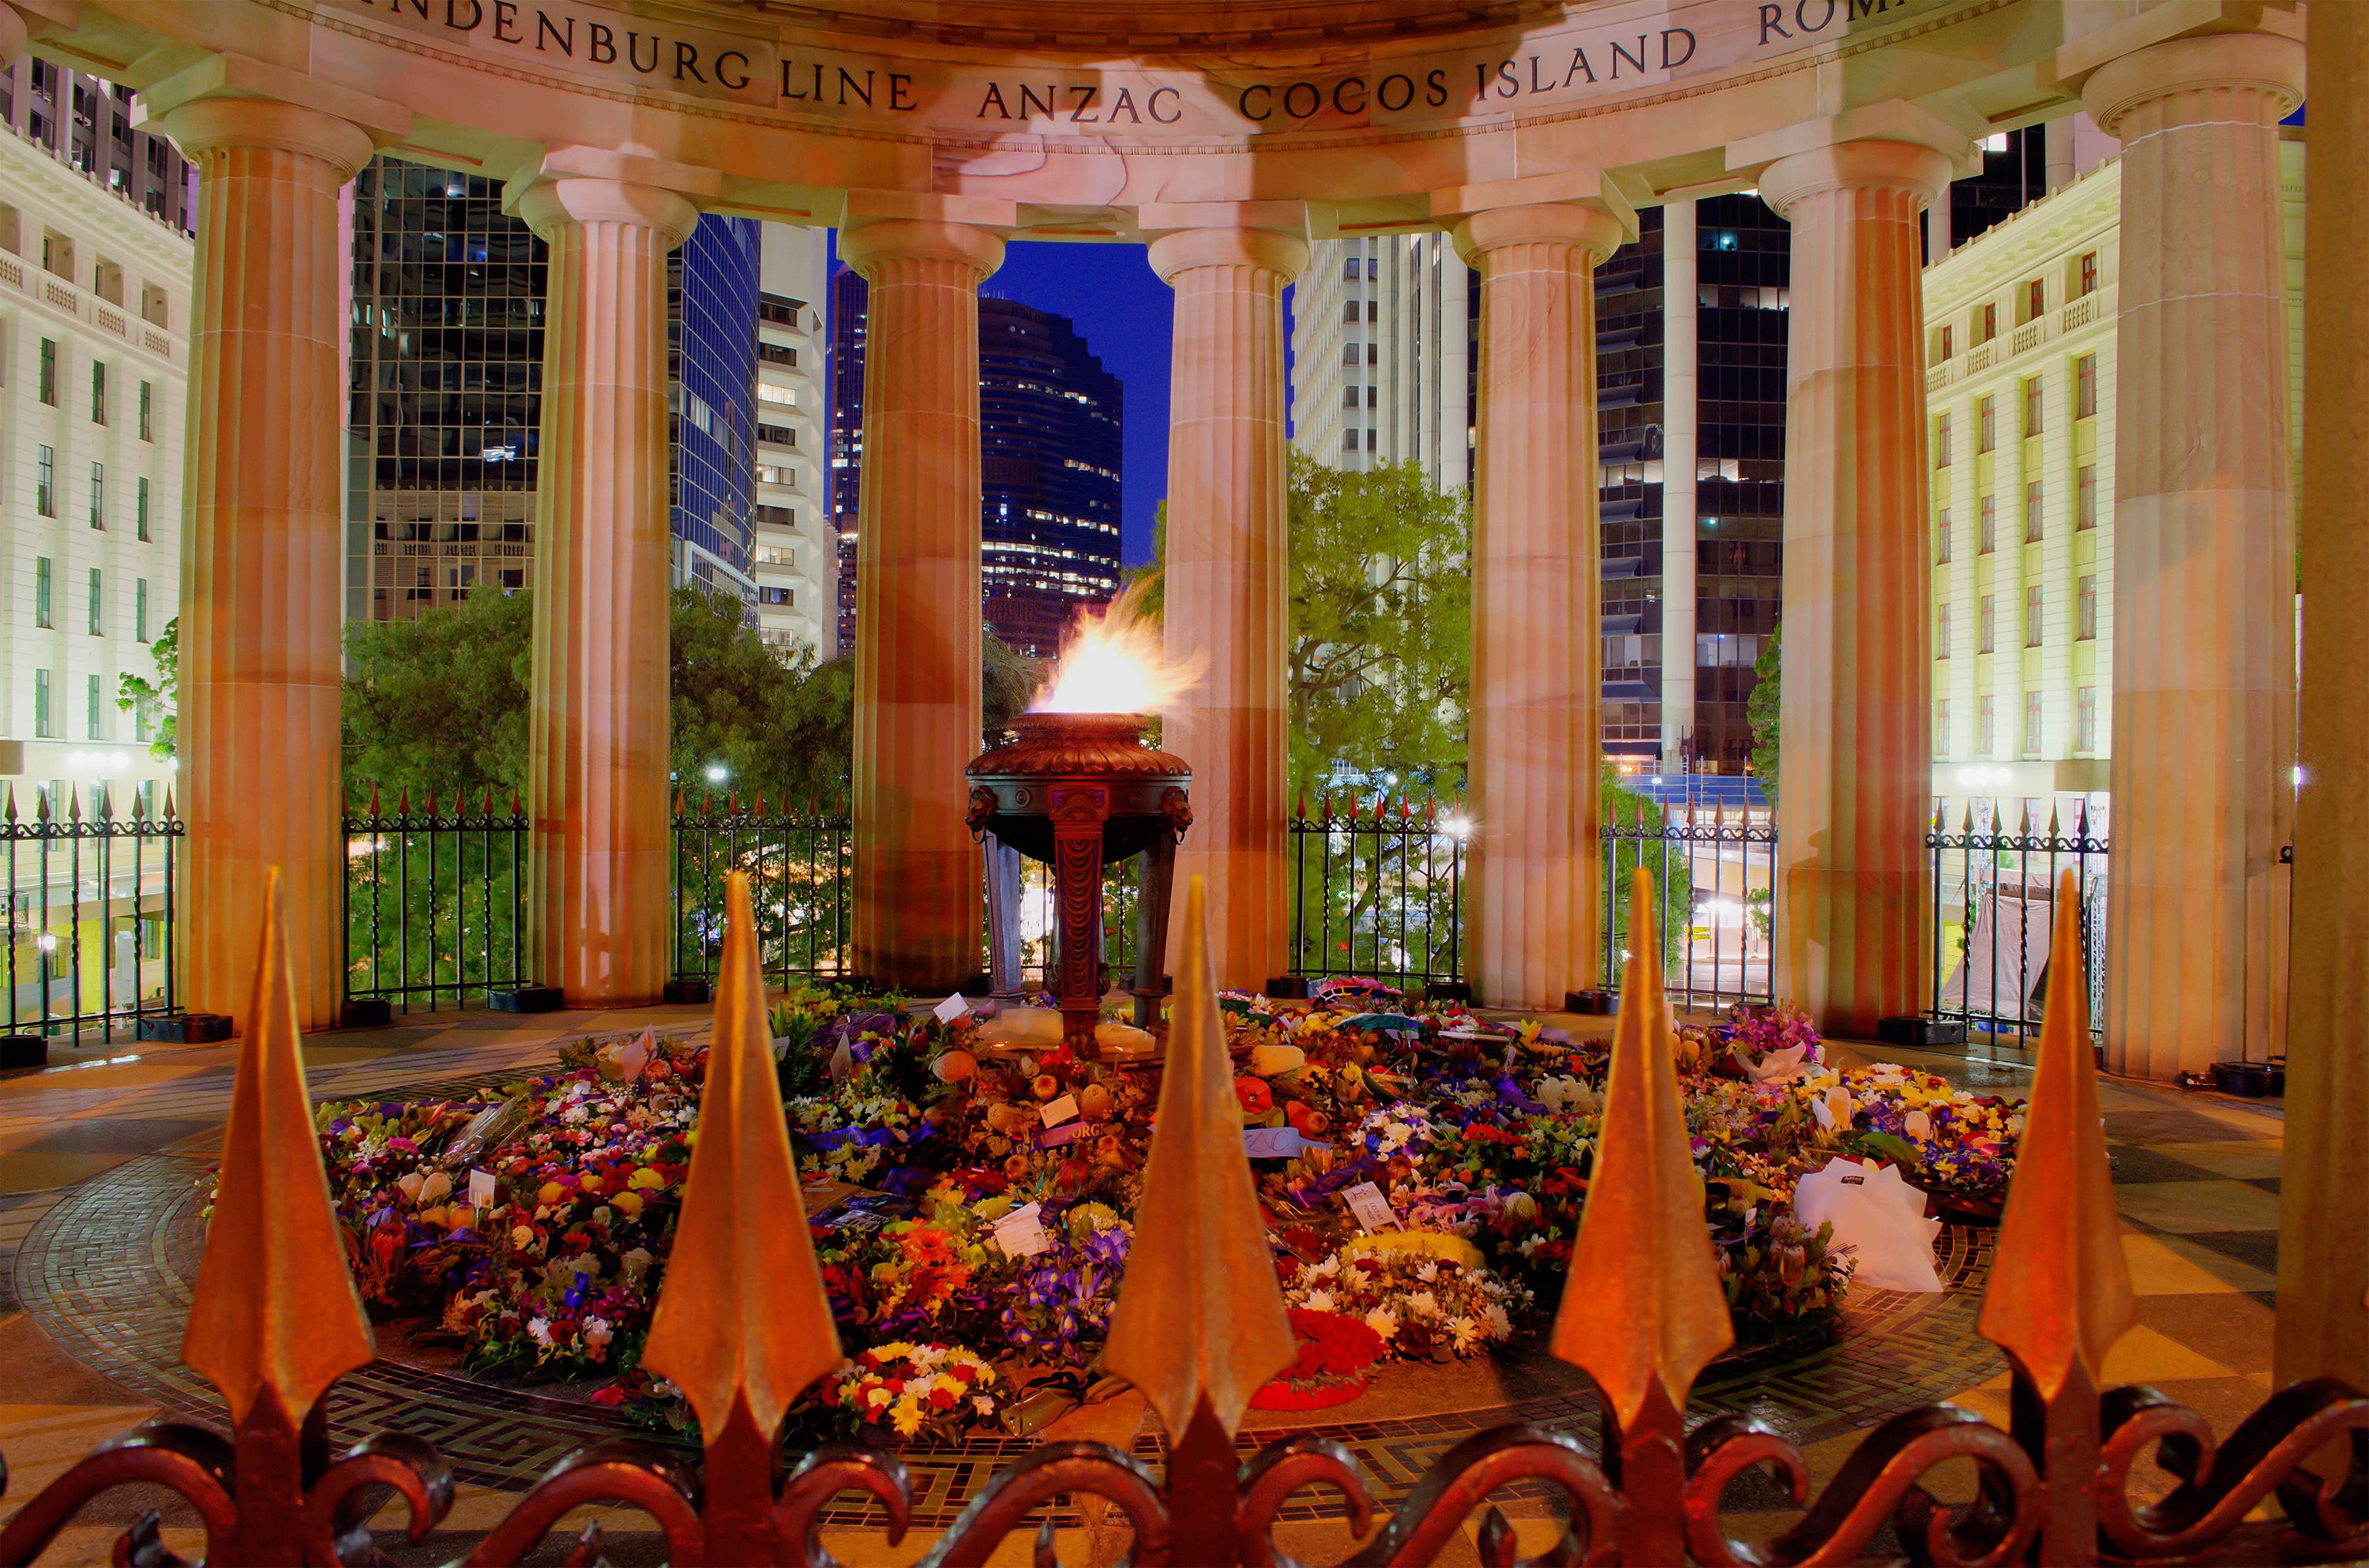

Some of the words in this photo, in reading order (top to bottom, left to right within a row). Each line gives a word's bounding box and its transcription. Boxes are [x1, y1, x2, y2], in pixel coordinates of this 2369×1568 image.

[780, 59, 918, 111] LINE
[1239, 69, 1448, 121] COCOS
[1475, 28, 1696, 103] ISLAND
[976, 82, 1182, 124] ANZAC
